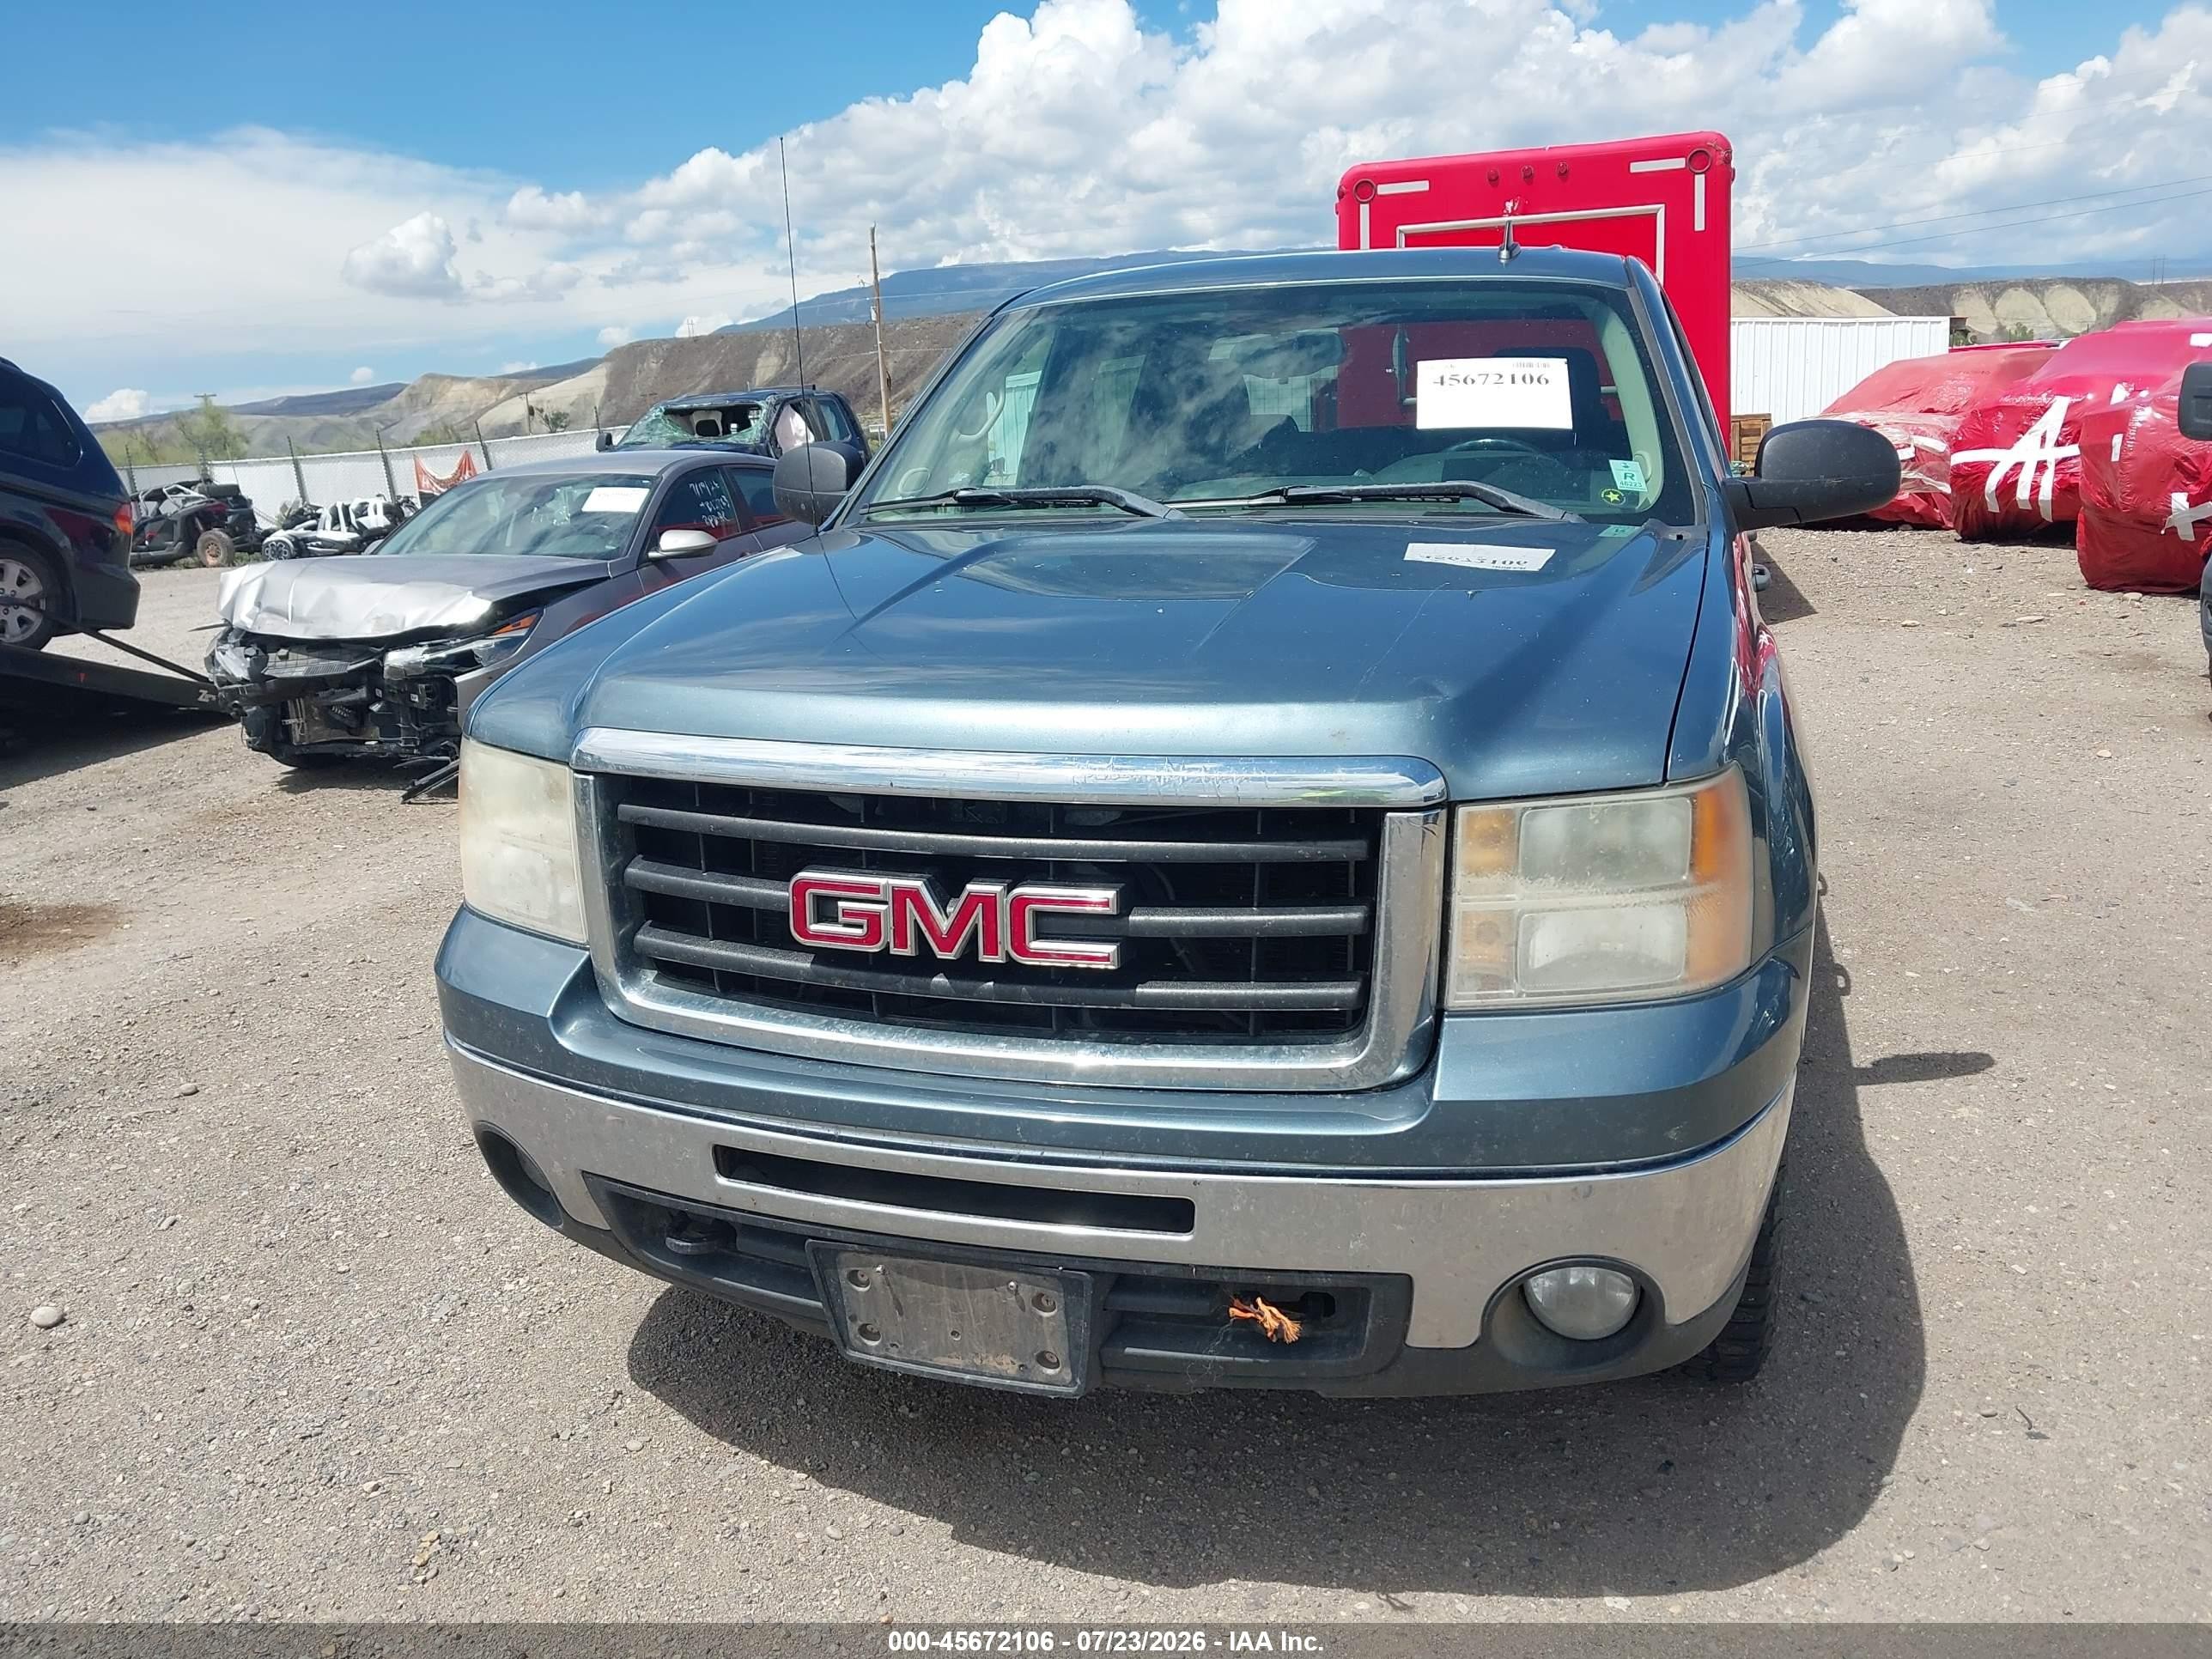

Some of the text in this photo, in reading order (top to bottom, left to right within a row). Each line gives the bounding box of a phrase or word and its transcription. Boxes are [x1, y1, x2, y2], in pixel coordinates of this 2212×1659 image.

[1432, 373, 1549, 386] 45672106
[1623, 471, 1636, 482] R
[789, 868, 1121, 969] GMC
